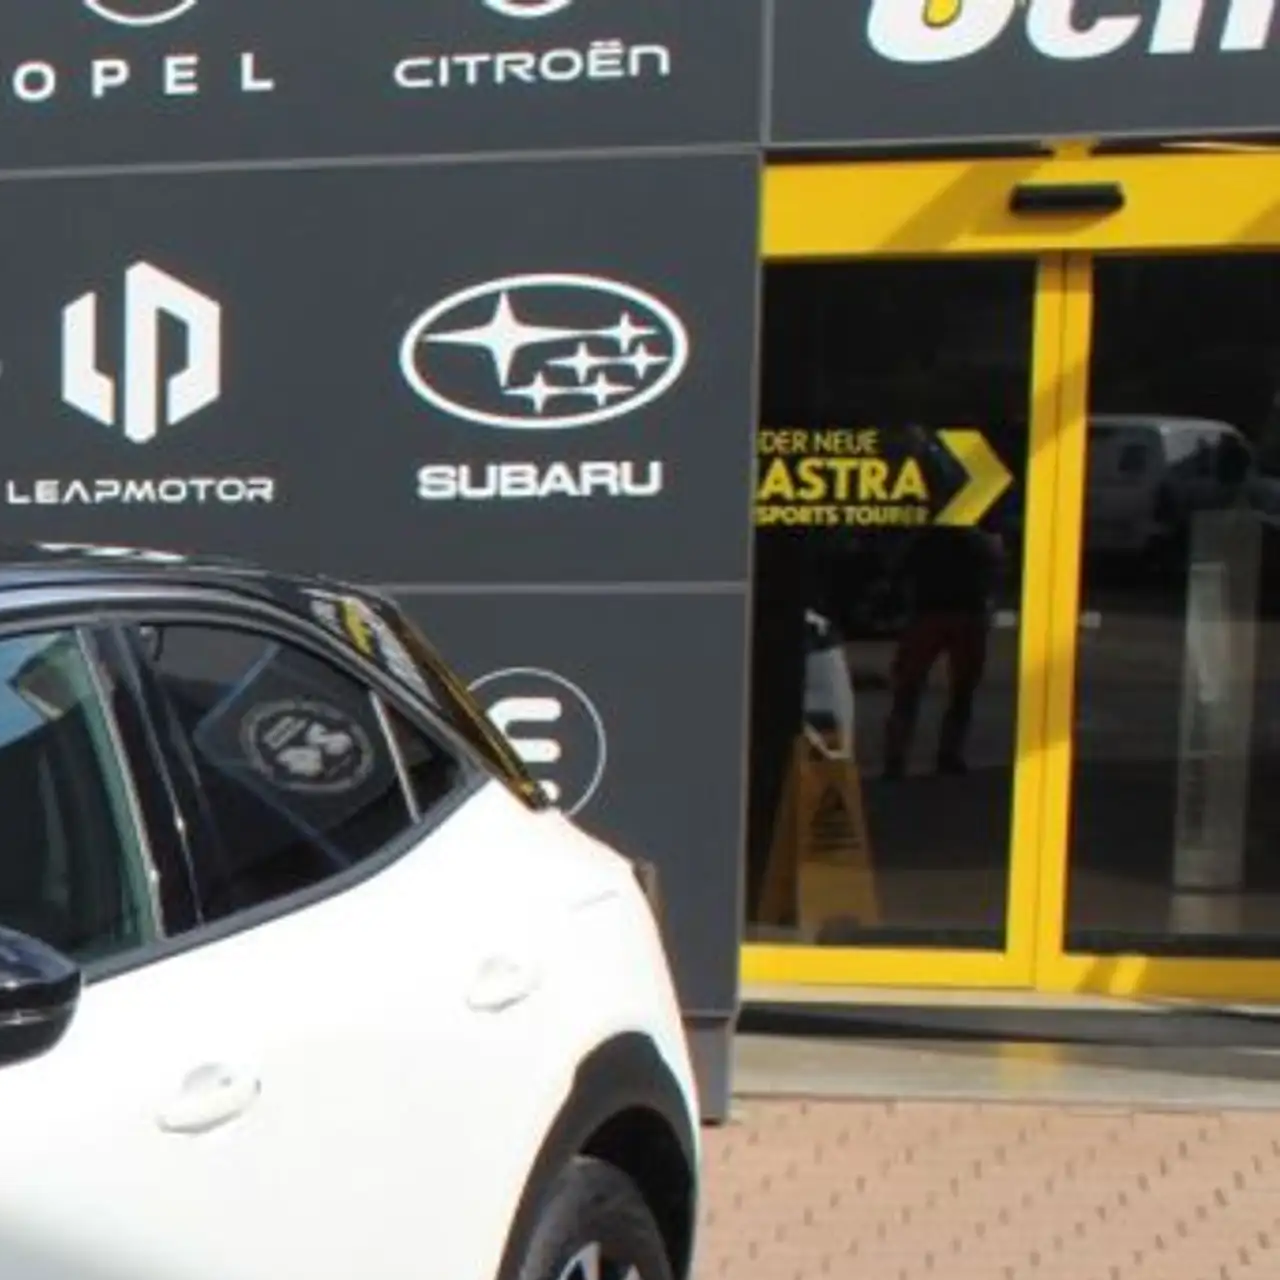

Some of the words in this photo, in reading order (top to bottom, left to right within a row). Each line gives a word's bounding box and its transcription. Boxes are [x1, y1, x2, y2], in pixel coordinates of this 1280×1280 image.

[13, 53, 274, 101] OPEL
[758, 430, 809, 453] DER
[814, 429, 878, 453] NEUE
[6, 478, 275, 504] LEAPMOTOR
[417, 461, 662, 499] SUBARU
[759, 456, 929, 501] ASTRA
[756, 505, 838, 526] SPORTS
